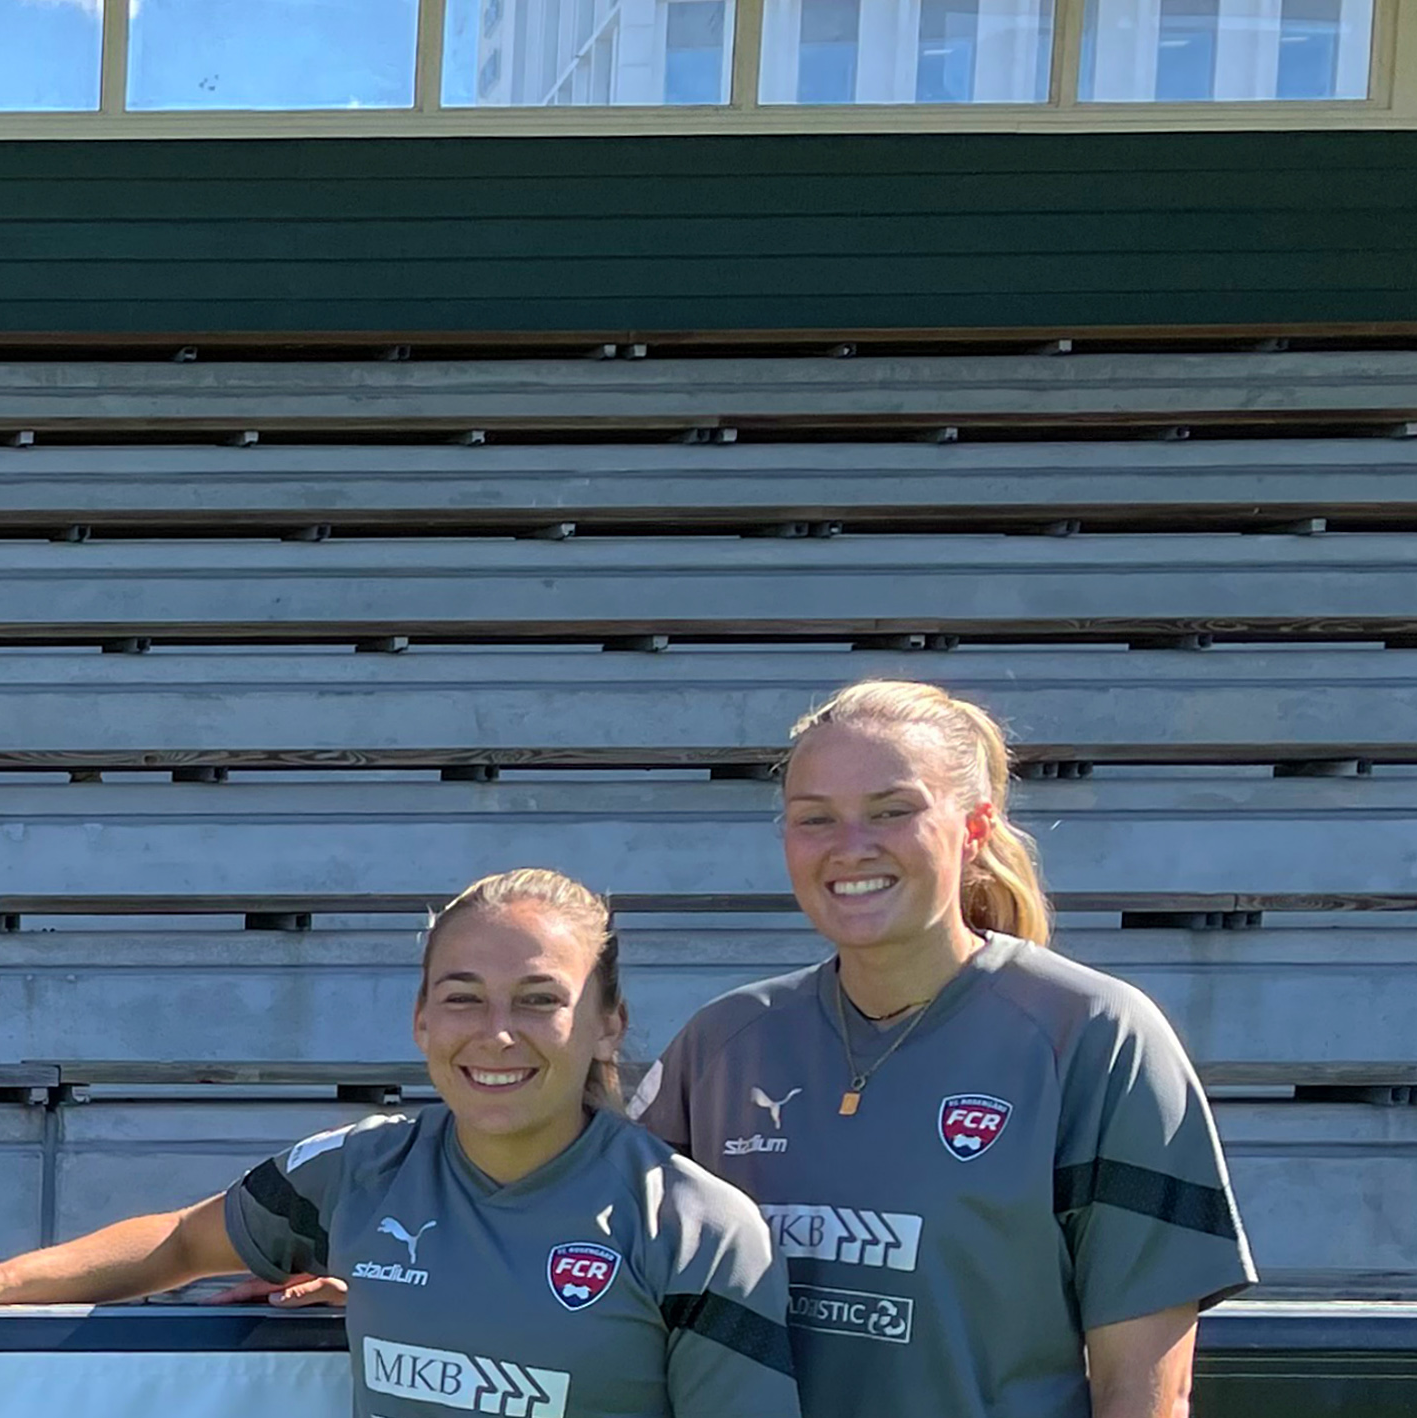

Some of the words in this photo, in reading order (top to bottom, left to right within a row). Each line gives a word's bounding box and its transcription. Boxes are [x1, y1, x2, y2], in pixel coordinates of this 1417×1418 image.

[946, 1109, 1001, 1131] FCR
[352, 1261, 429, 1286] stadium
[555, 1257, 608, 1280] FCR
[372, 1348, 463, 1396] MKB
